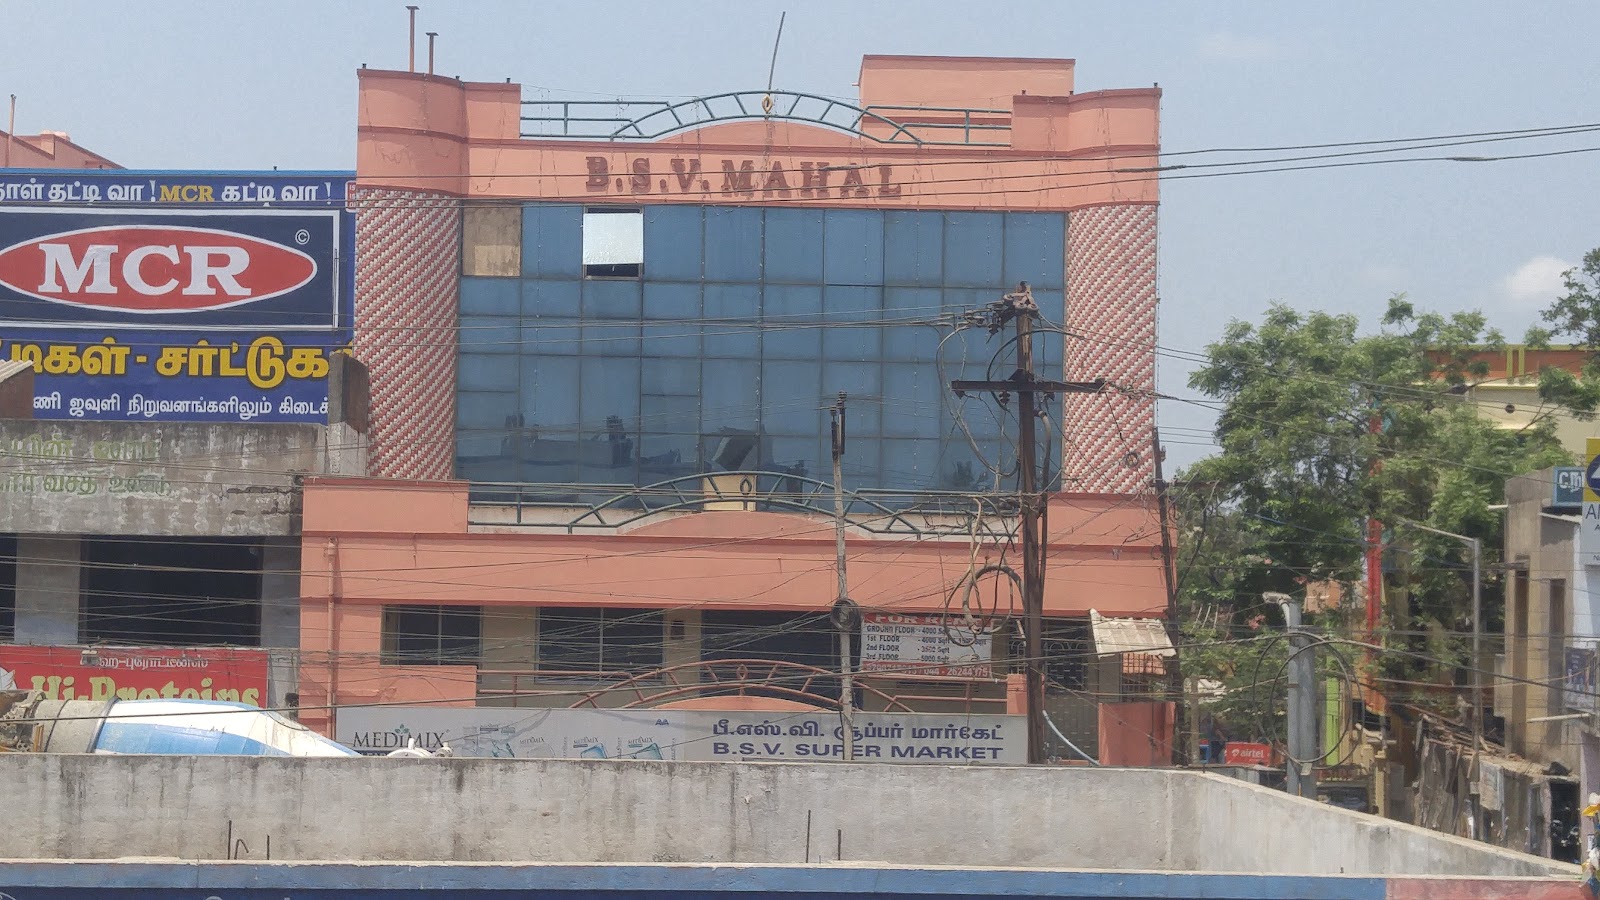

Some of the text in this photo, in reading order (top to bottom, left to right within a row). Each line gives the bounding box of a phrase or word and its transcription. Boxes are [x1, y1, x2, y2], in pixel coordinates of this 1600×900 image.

[48, 180, 102, 206] தட்டி
[159, 185, 215, 202] MCR
[221, 182, 276, 207] கட்டி
[38, 243, 252, 296] MCR
[0, 336, 131, 375] டிகள்
[156, 336, 353, 389] சர்ட்டுக
[713, 743, 1004, 759] B.S.V. SUPER MARKET
